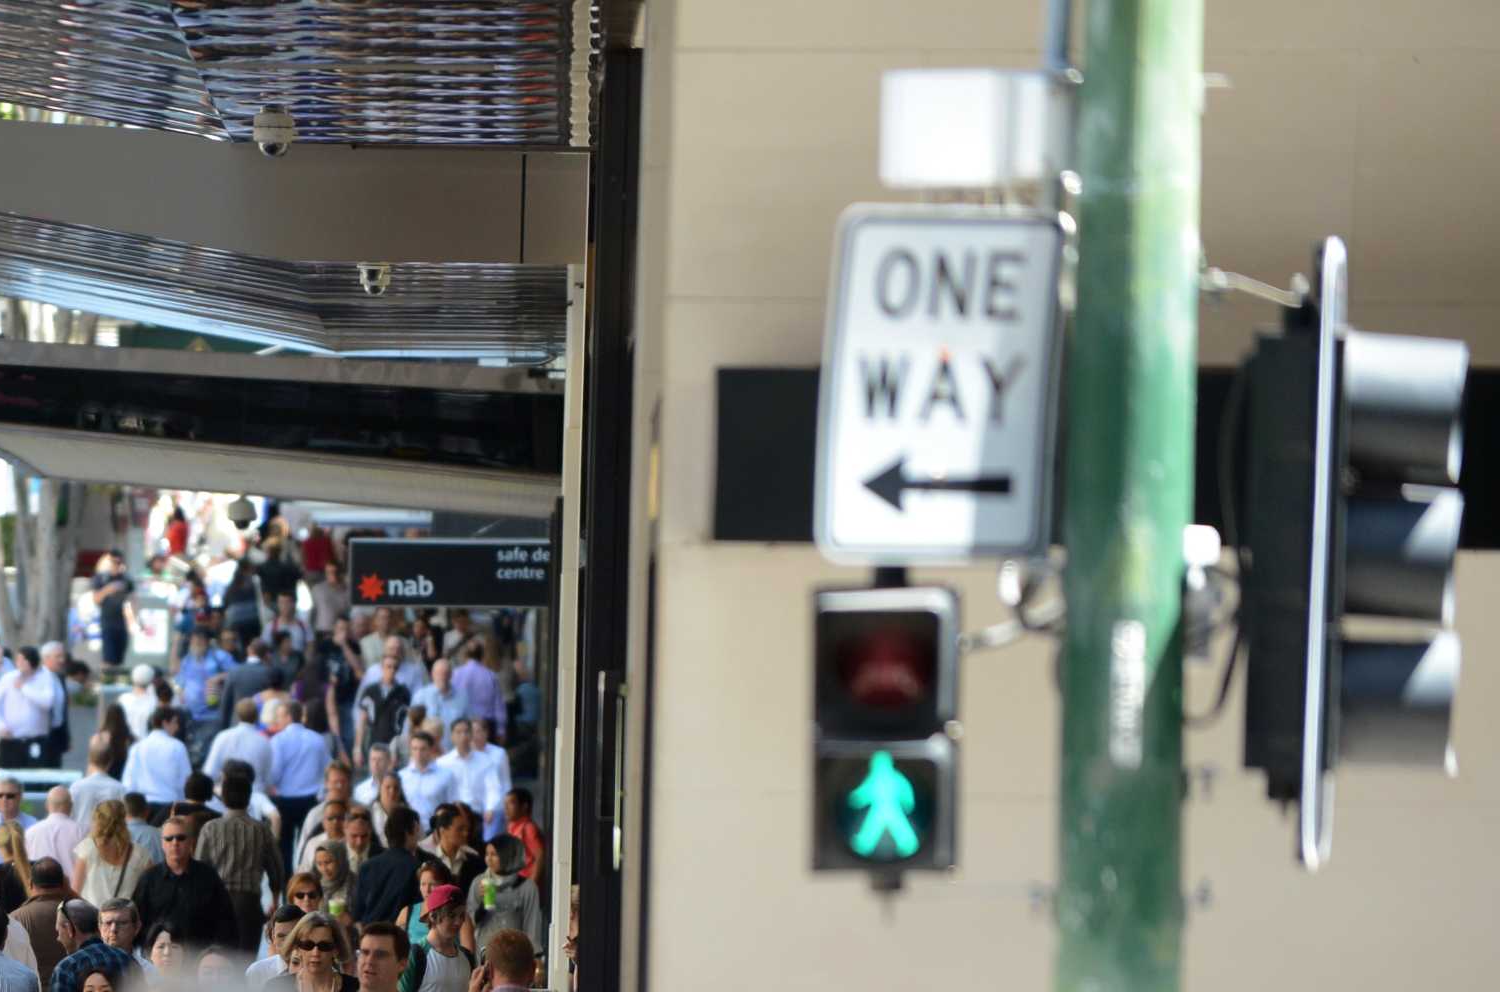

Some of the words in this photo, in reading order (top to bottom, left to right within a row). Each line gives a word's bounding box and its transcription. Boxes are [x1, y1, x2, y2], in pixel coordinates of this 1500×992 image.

[874, 247, 1028, 322] ONE
[858, 350, 1026, 424] WAY
[497, 548, 528, 562] safe
[497, 567, 545, 580] centre
[388, 574, 434, 597] nab
